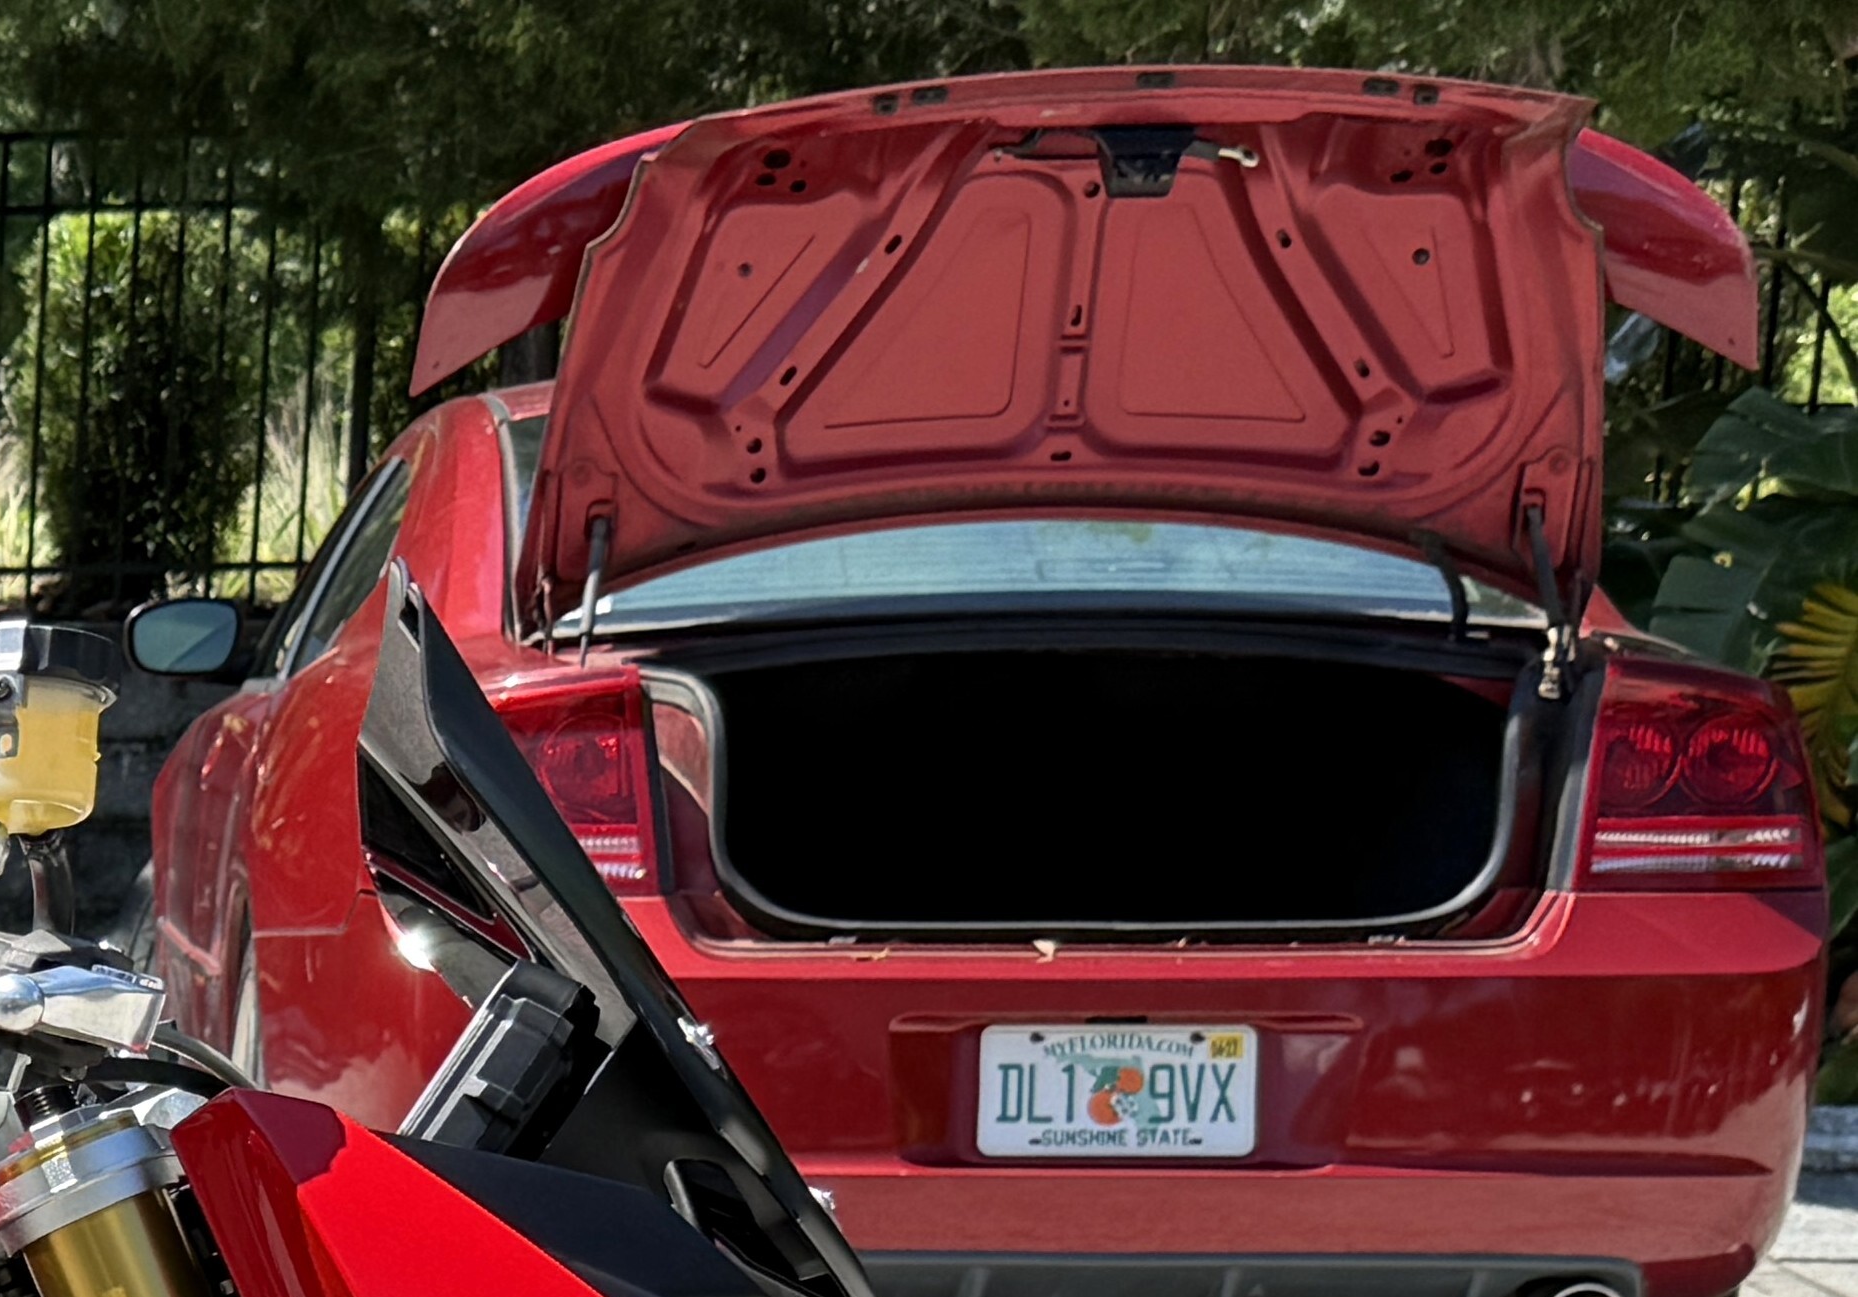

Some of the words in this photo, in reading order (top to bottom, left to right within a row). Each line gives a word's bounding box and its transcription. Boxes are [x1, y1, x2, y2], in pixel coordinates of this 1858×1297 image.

[996, 1063, 1075, 1124] DL1
[1148, 1063, 1237, 1124] 9VX
[1040, 1127, 1127, 1147] SUNSHINE
[1136, 1127, 1192, 1147] STATE
